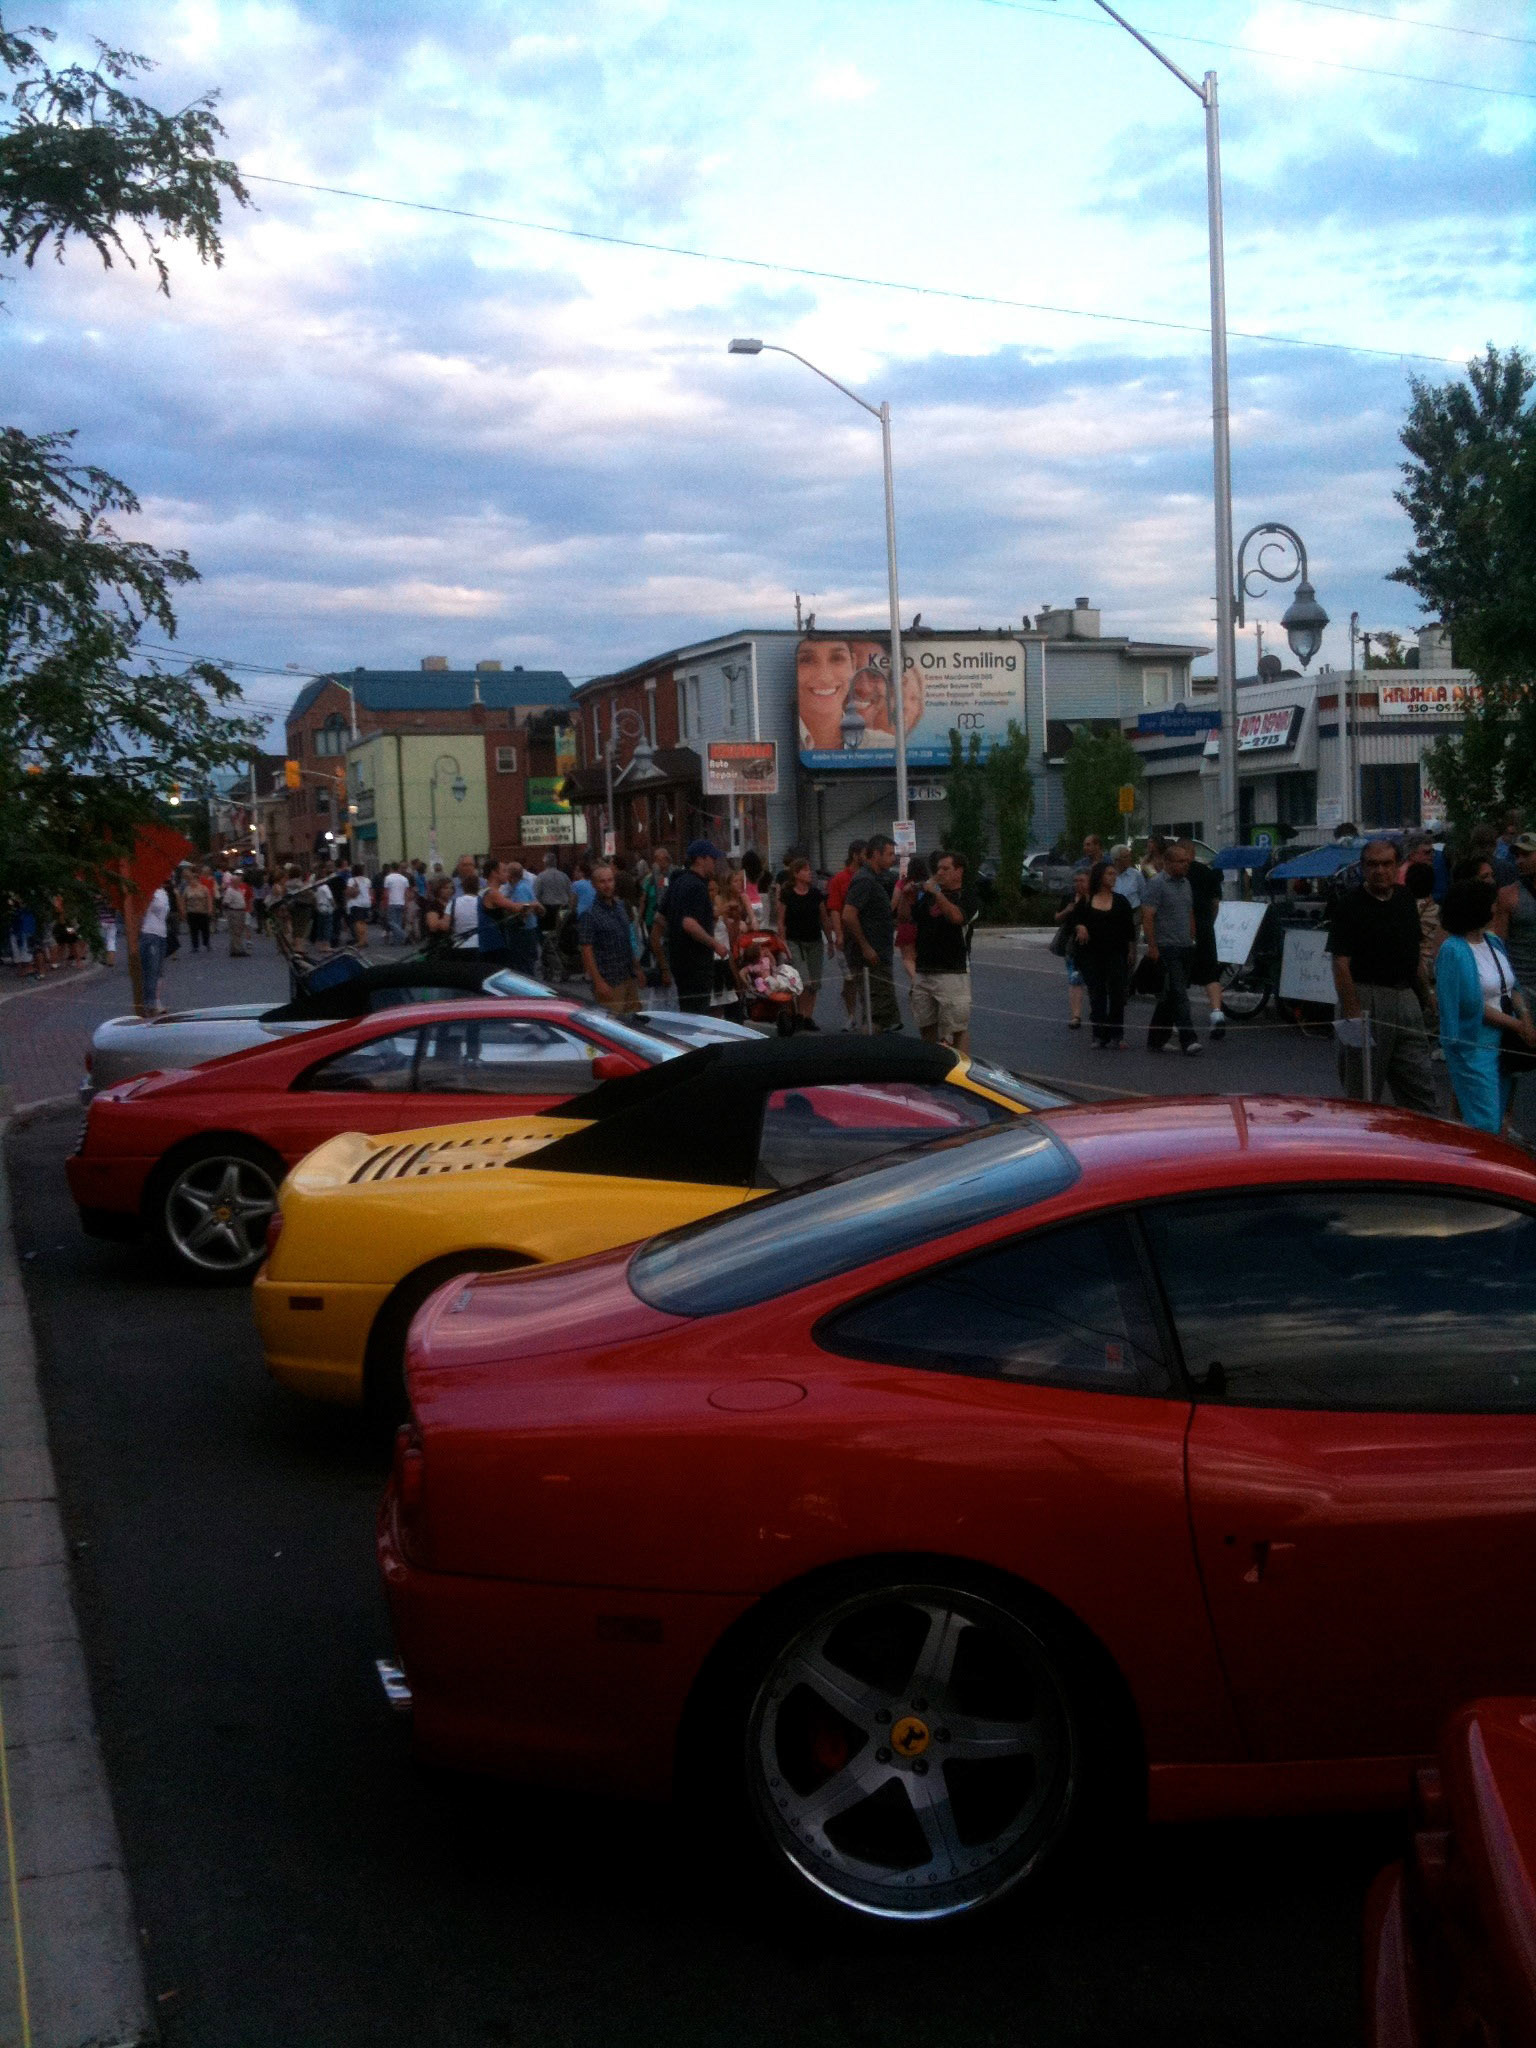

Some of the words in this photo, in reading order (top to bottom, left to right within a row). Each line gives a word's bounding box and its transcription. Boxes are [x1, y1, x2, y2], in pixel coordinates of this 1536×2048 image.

[868, 652, 915, 672] Kep
[920, 652, 947, 669] On
[952, 651, 1017, 672] Smiling
[1383, 686, 1448, 703] KRISHNA
[709, 760, 729, 769] Auto
[918, 786, 943, 800] CBS
